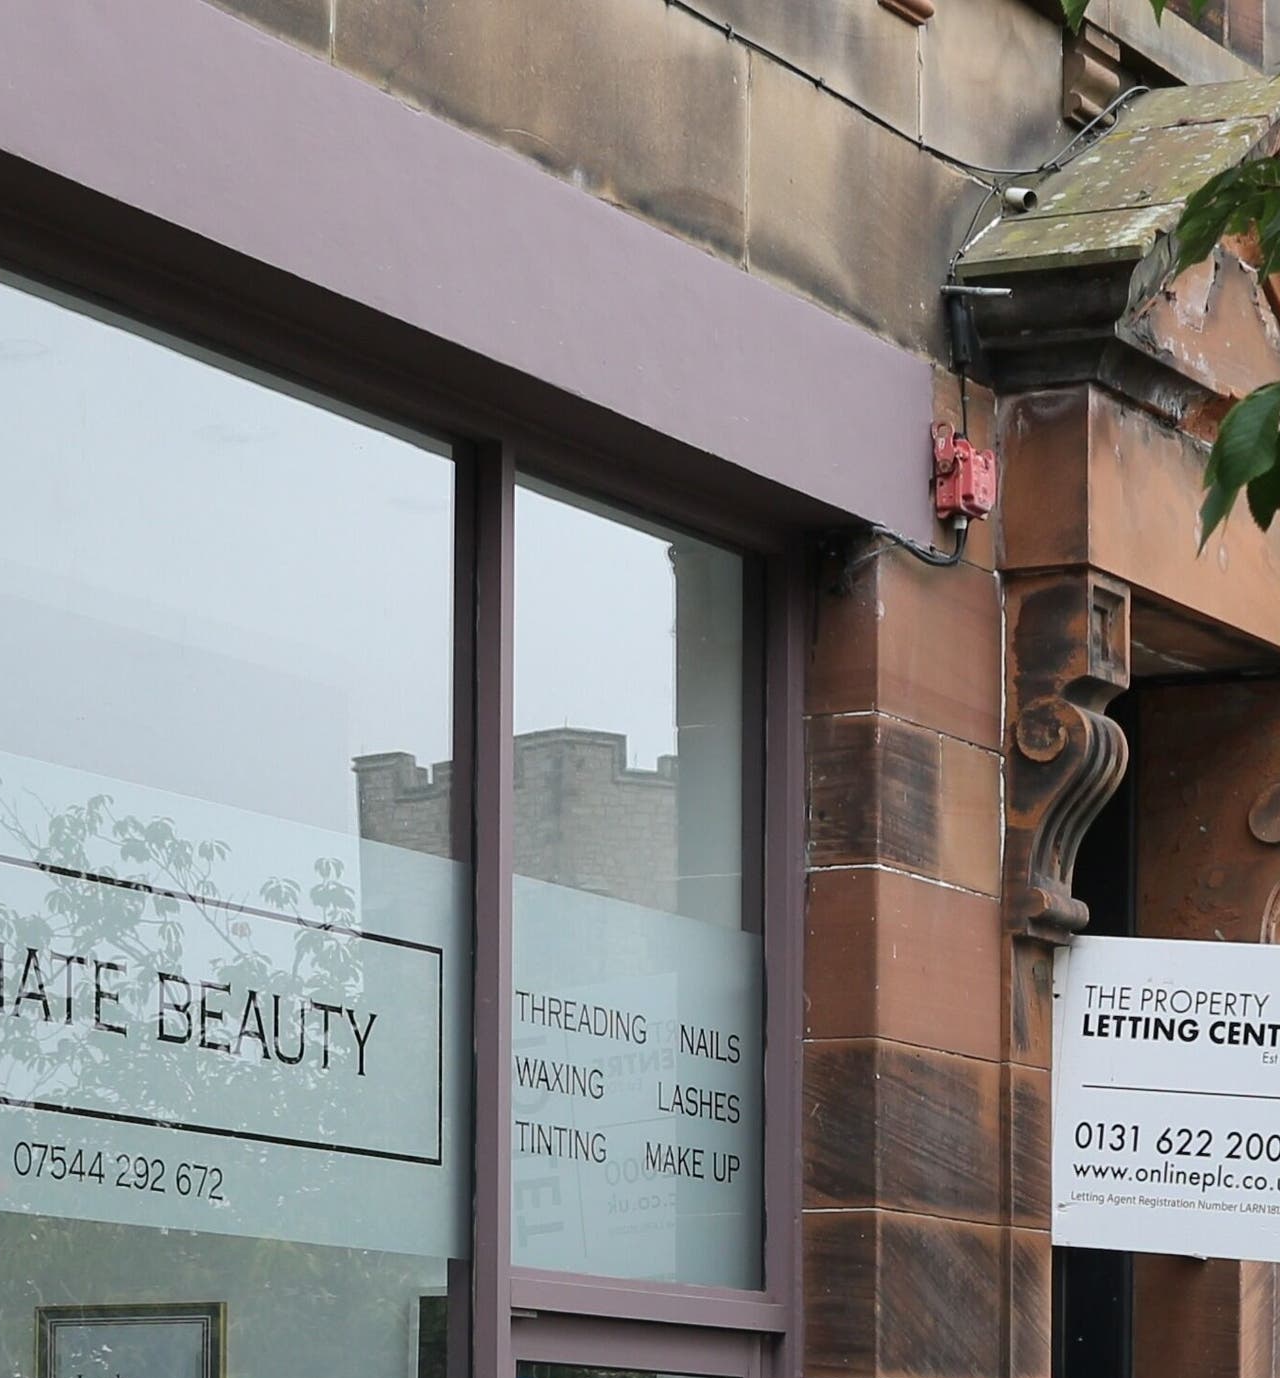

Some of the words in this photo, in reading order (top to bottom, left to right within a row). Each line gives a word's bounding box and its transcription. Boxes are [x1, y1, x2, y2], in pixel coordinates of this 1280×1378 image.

[516, 990, 647, 1044] THREADING
[1085, 985, 1132, 1012] THE
[1140, 989, 1270, 1018] PROPERTY
[156, 972, 377, 1075] BEAUTY
[680, 1024, 741, 1063] NAILS
[1082, 1014, 1199, 1043] LETTING
[516, 1056, 604, 1099] WAXING
[1262, 1051, 1279, 1065] Est
[657, 1082, 740, 1123] LASHES
[516, 1121, 607, 1163] TINTING
[1074, 1121, 1139, 1154] 0131
[1156, 1127, 1213, 1158] 622
[13, 1141, 104, 1185] 07544
[115, 1153, 166, 1192] 292
[175, 1163, 224, 1199] 672
[645, 1142, 704, 1178] MAKE
[713, 1153, 740, 1183] UP
[1071, 1191, 1105, 1204] Letting
[1108, 1194, 1136, 1206] Agent
[1139, 1196, 1196, 1209] Registration
[1198, 1200, 1237, 1212] Number
